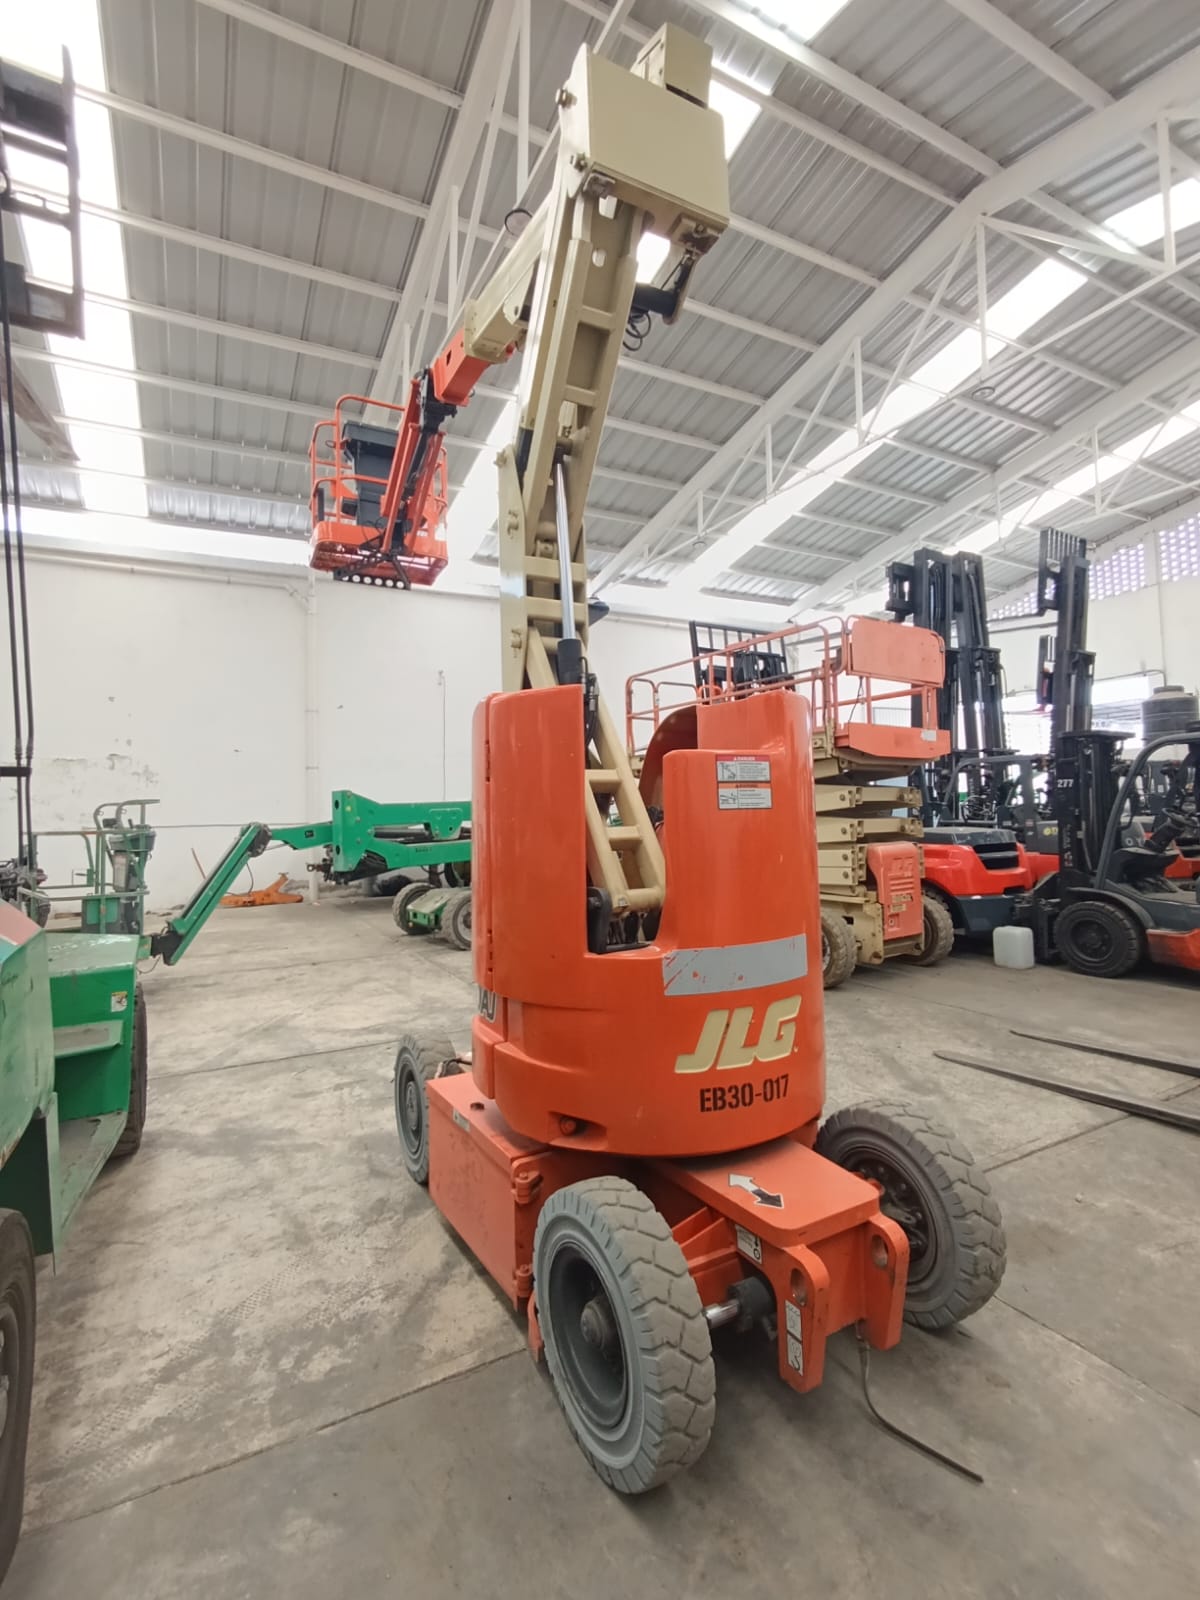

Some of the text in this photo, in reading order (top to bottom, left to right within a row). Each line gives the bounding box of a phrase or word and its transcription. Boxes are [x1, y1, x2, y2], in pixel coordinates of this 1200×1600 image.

[1057, 779, 1074, 788] 277
[674, 995, 802, 1074] JLG
[699, 1073, 790, 1113] EB30-017
